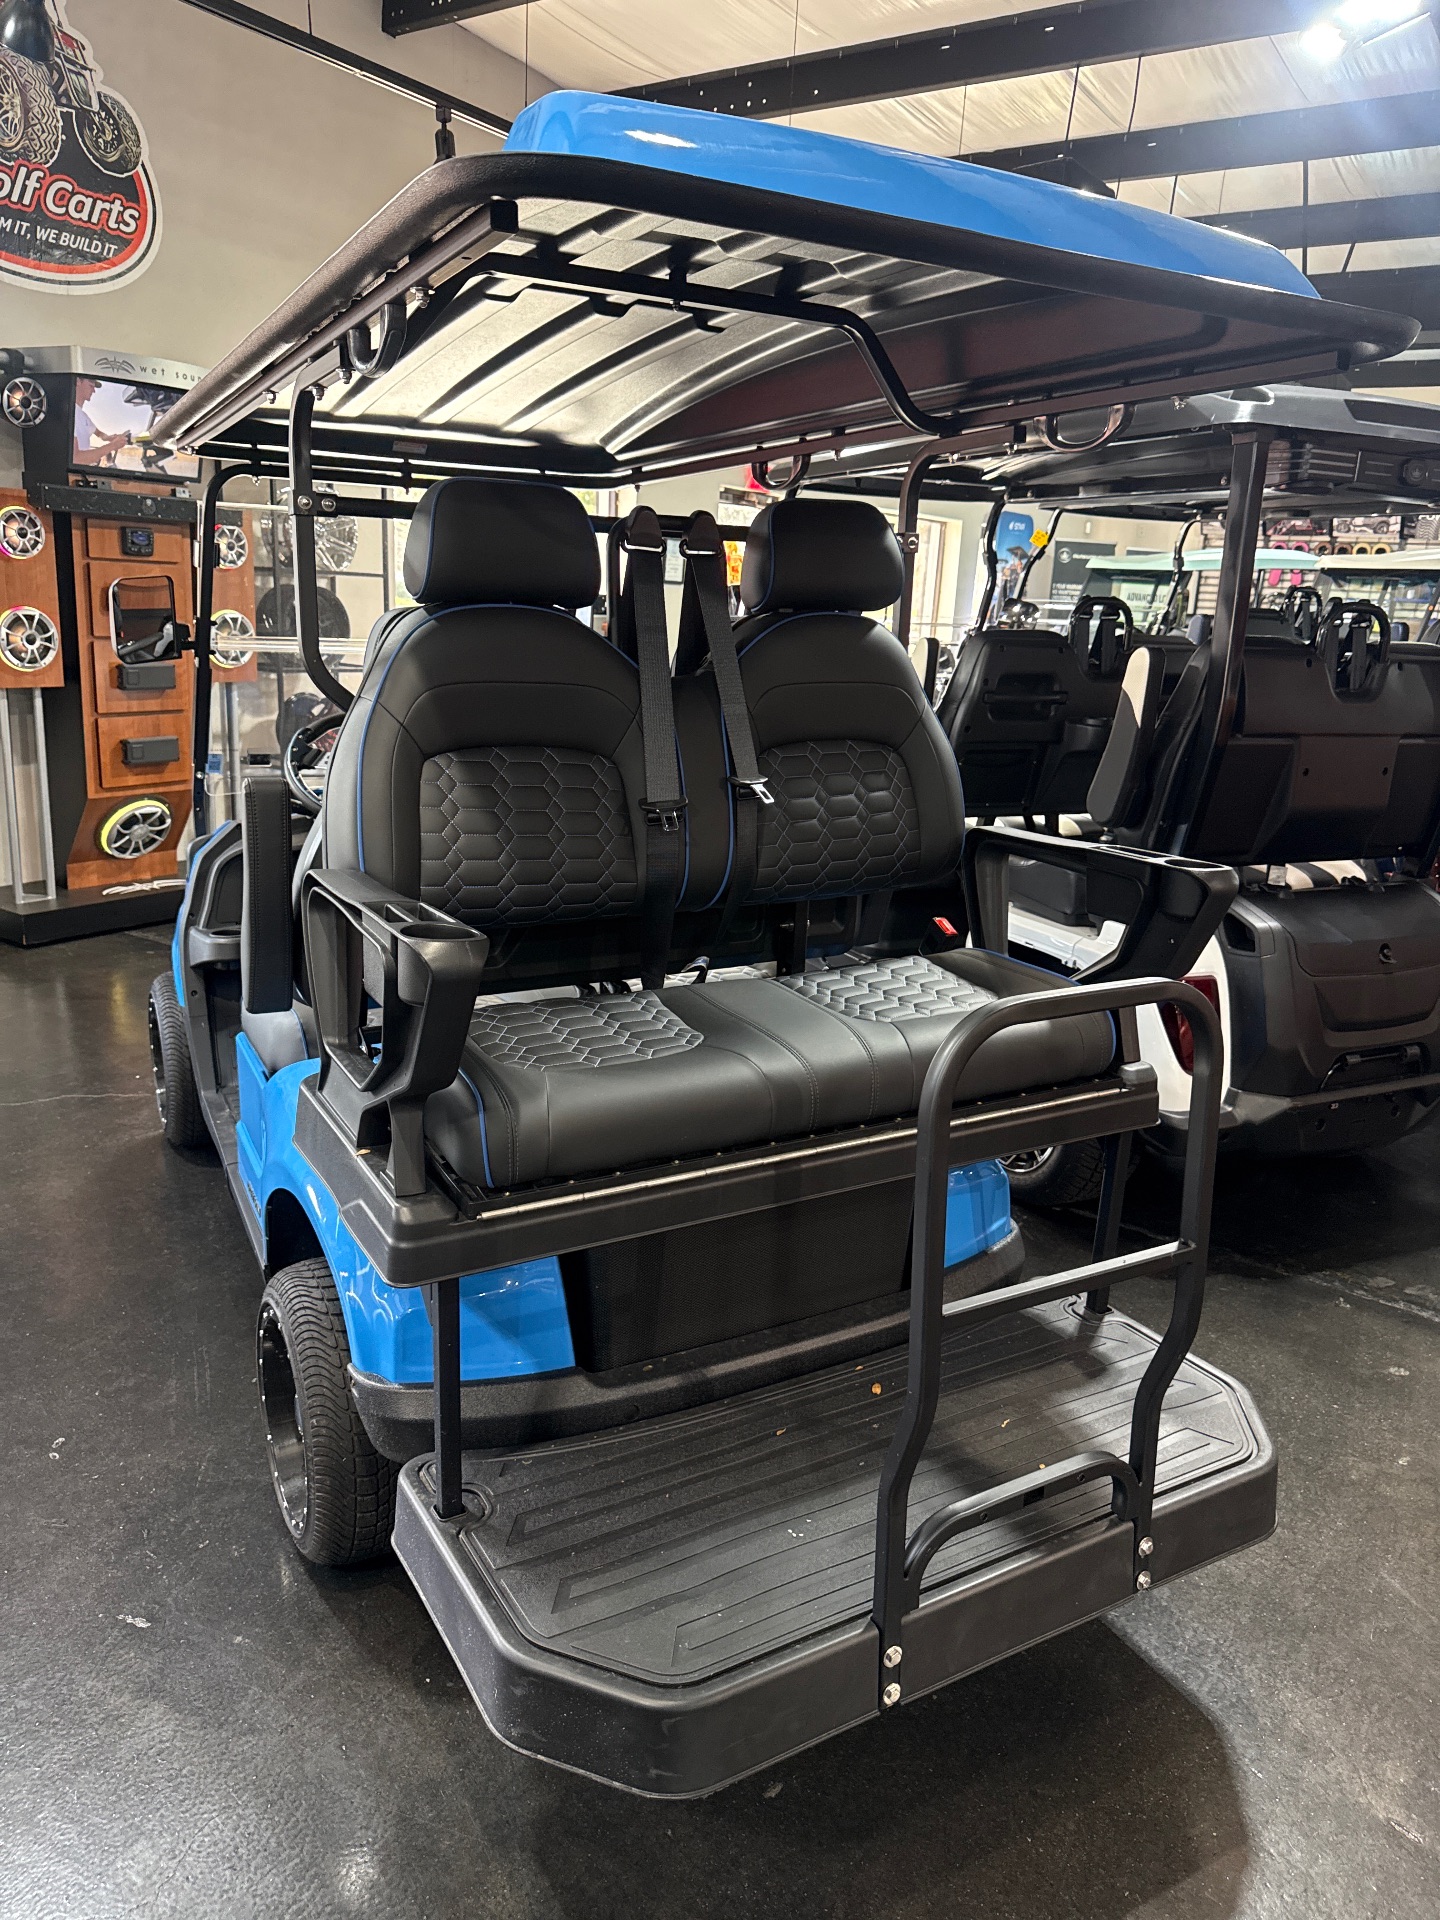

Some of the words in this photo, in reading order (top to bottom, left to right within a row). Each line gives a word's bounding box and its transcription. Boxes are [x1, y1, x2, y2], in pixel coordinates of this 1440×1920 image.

[46, 180, 140, 233] Carts
[14, 220, 31, 240] IT,
[36, 225, 60, 244] WE
[60, 232, 102, 254] BUILD
[103, 242, 118, 258] IT
[140, 365, 165, 376] wet
[1126, 592, 1158, 602] ADVANCD
